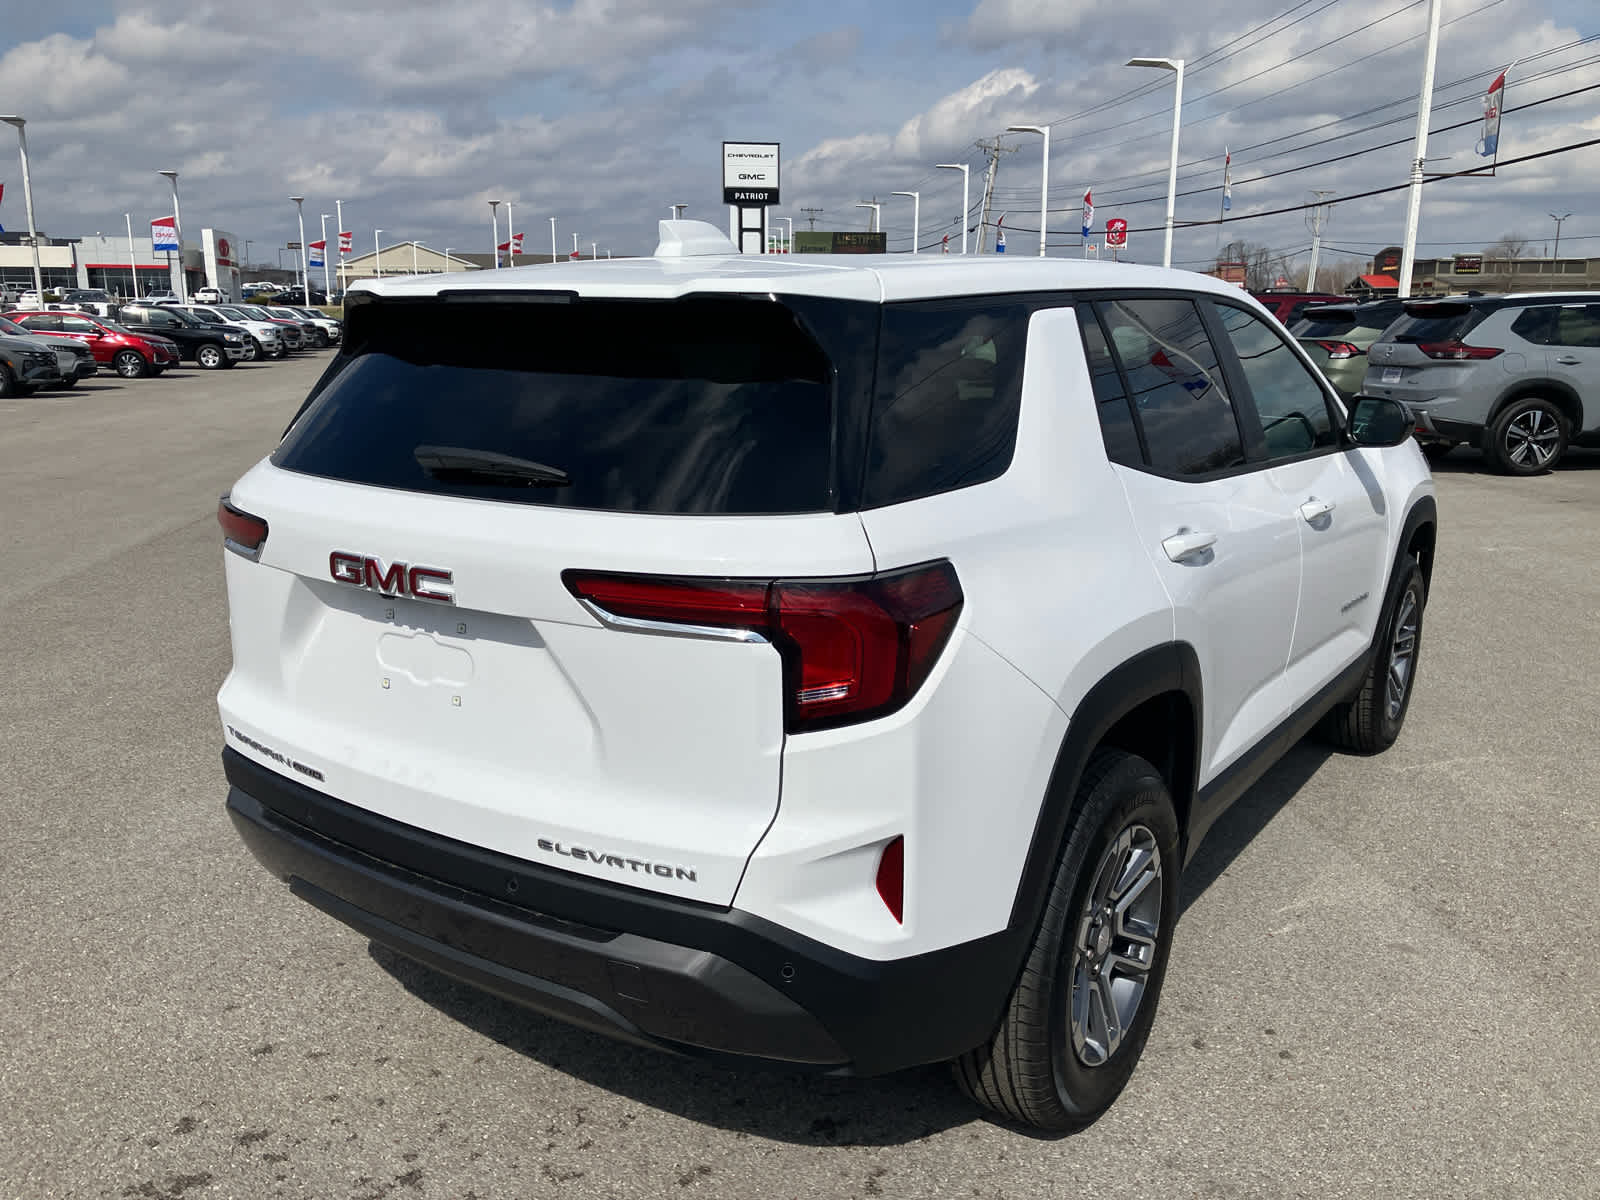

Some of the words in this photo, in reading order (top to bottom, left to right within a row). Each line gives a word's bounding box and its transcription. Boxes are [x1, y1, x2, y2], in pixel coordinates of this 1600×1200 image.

[738, 173, 766, 181] GMC
[734, 192, 769, 200] PATRIOT
[329, 549, 456, 607] GMC
[536, 838, 698, 882] ELEVATION
